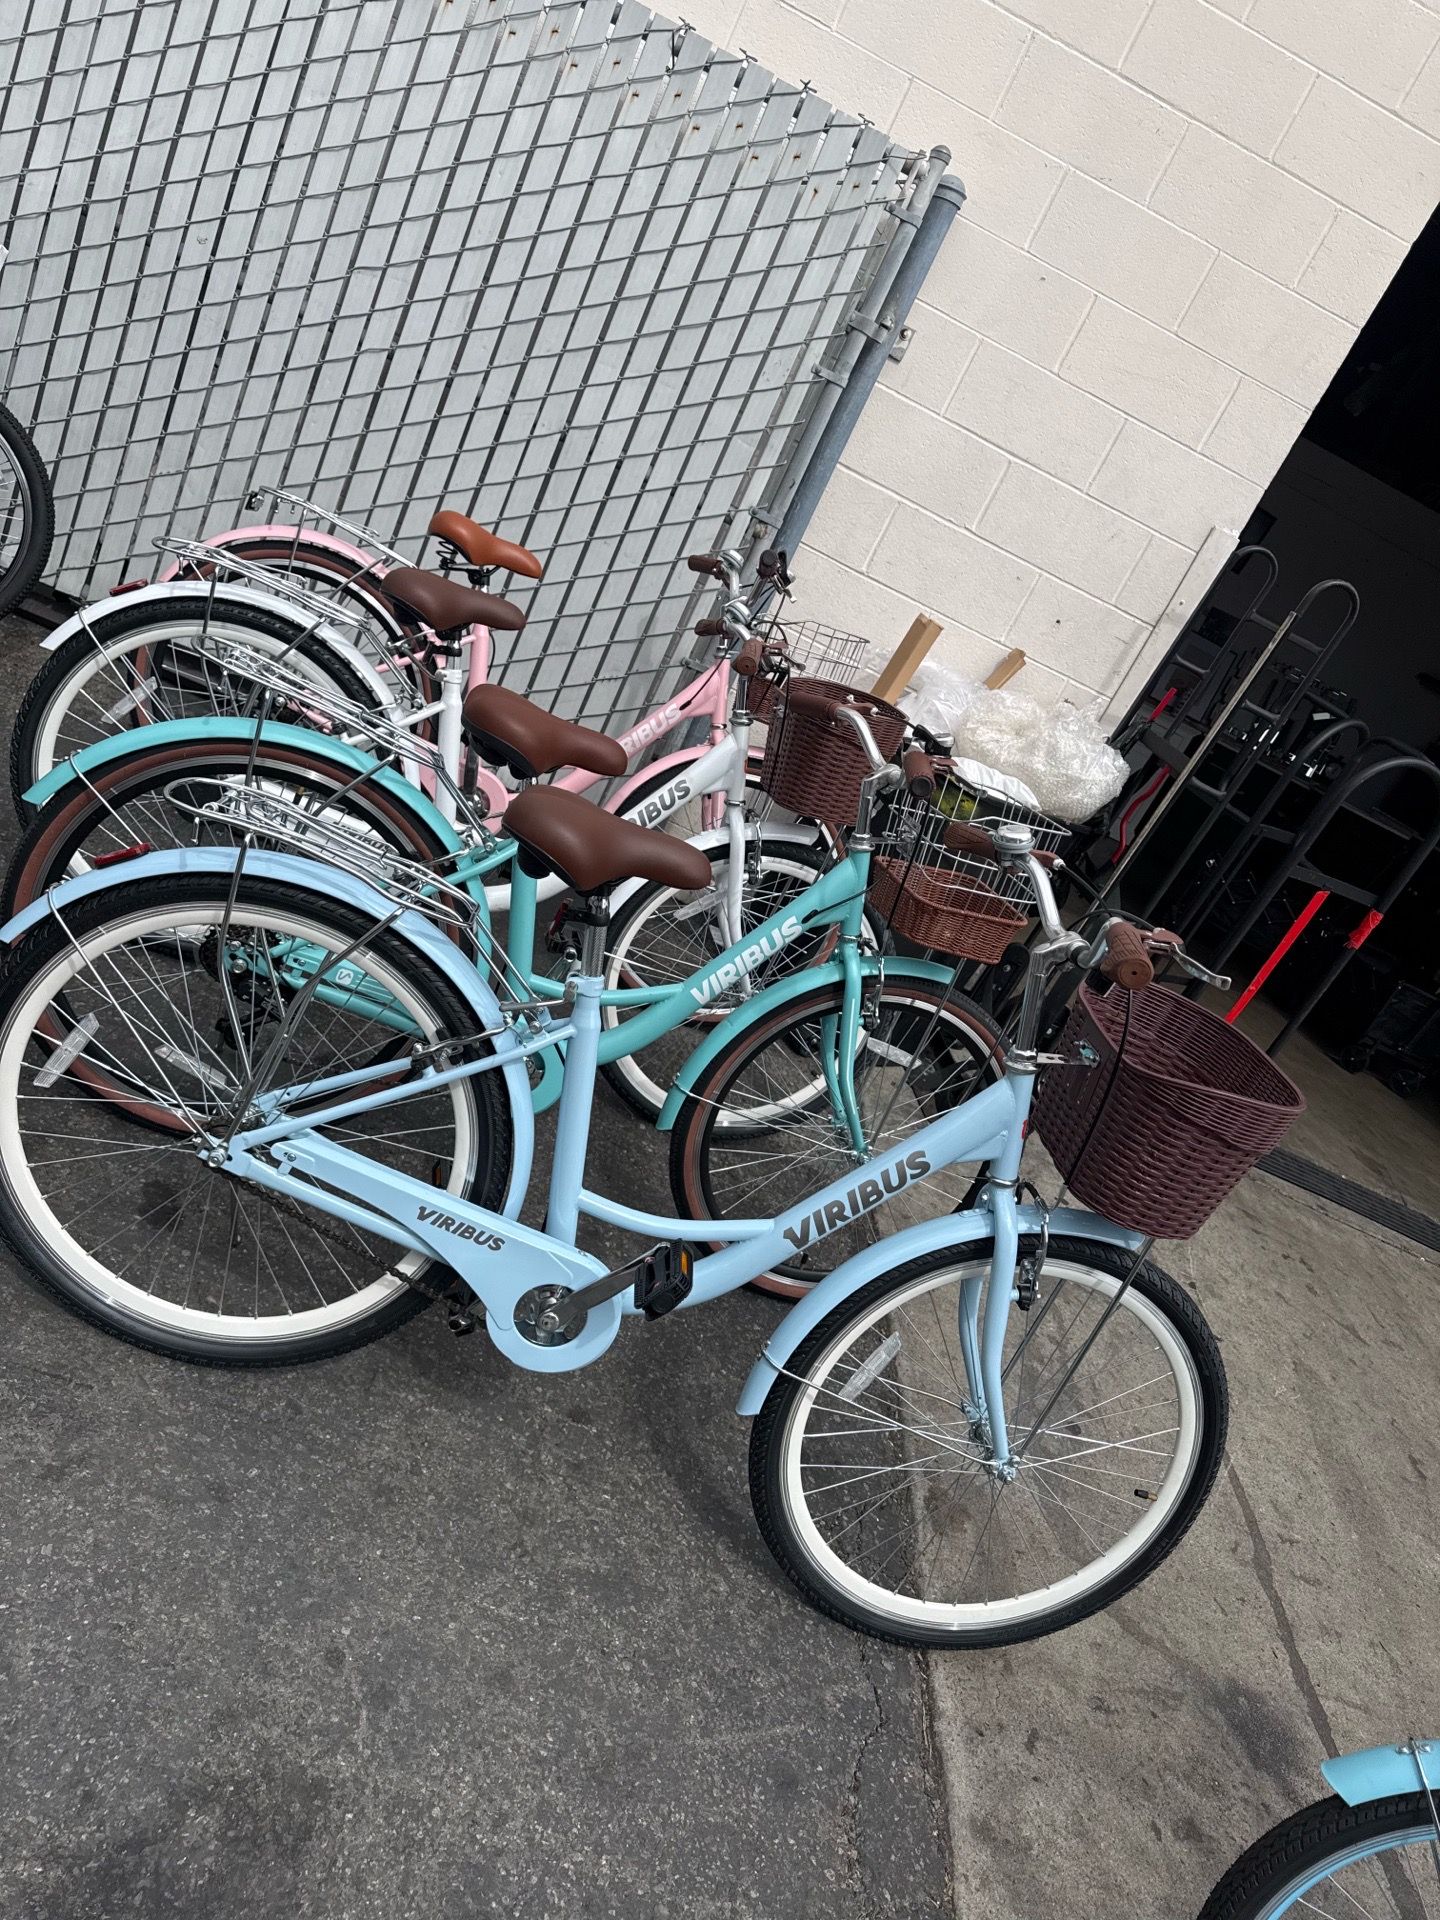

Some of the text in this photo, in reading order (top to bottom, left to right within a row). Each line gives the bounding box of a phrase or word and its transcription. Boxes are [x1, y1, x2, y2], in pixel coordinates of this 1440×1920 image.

[619, 703, 681, 753] RIBUS
[628, 779, 691, 829] IBUS
[690, 915, 802, 1005] VIRIBUS
[783, 1150, 931, 1250] VIRIBUS
[417, 1205, 505, 1251] VIRIBUS
